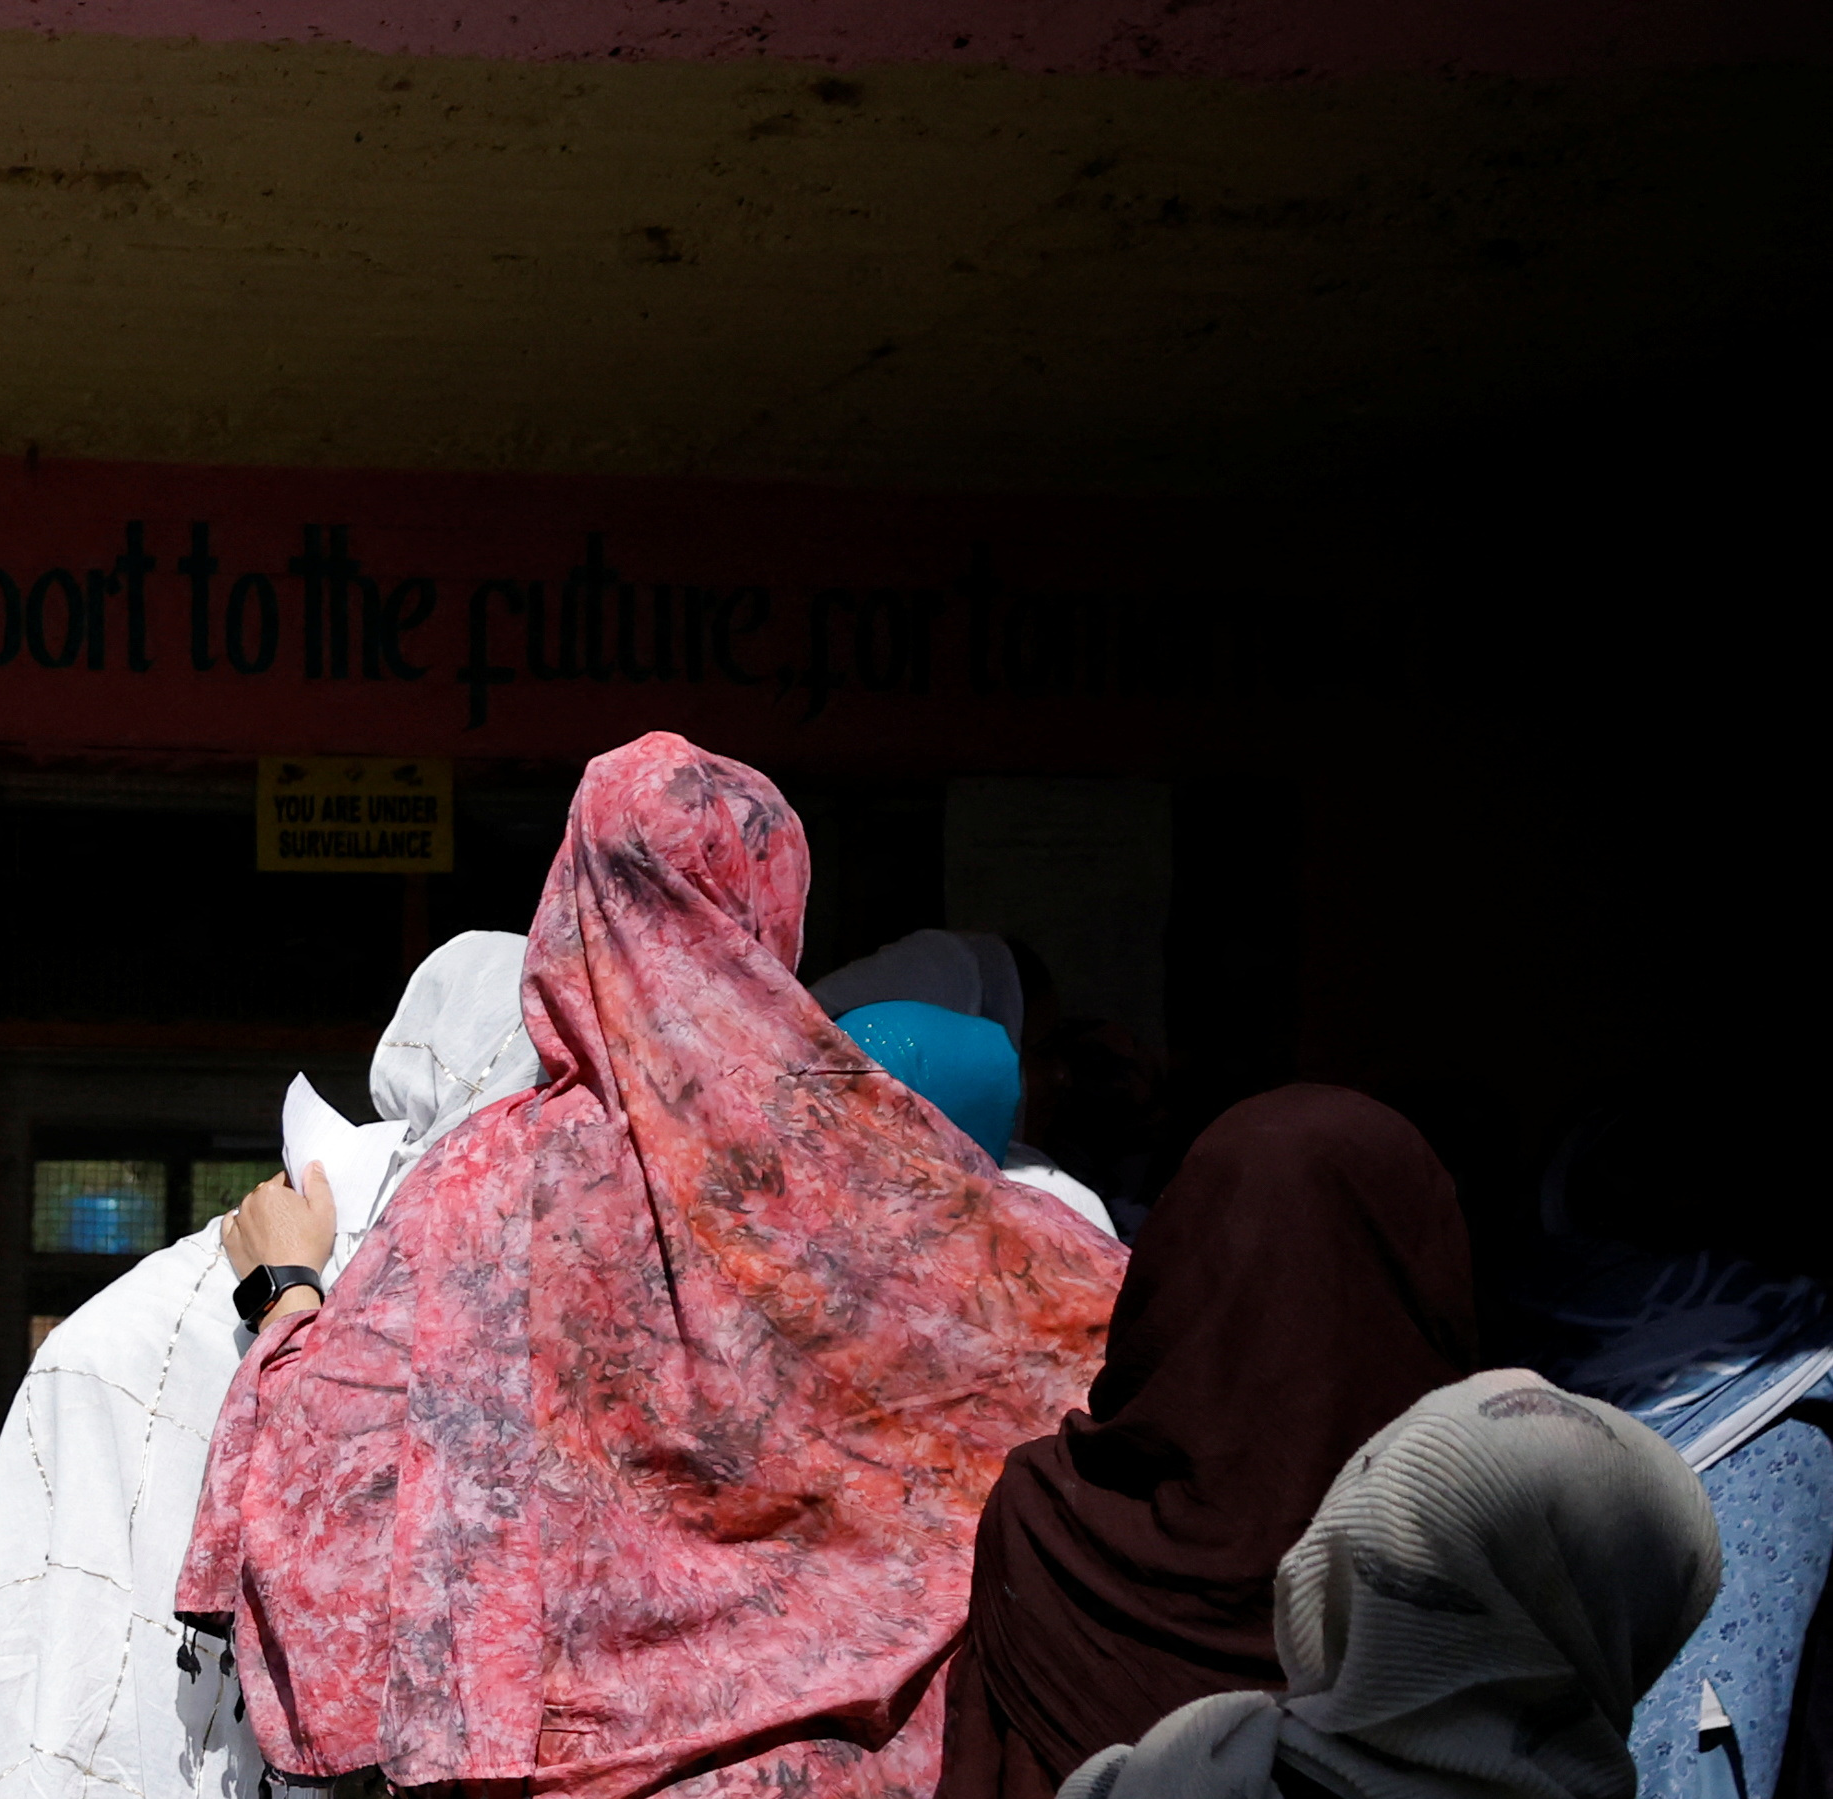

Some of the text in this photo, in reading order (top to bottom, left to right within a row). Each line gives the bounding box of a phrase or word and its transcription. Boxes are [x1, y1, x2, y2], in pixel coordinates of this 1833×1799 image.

[178, 521, 278, 674] to
[287, 522, 437, 681] the
[274, 795, 438, 824] YOU ARE UNDER
[279, 830, 433, 859] SURVEILLANCE
